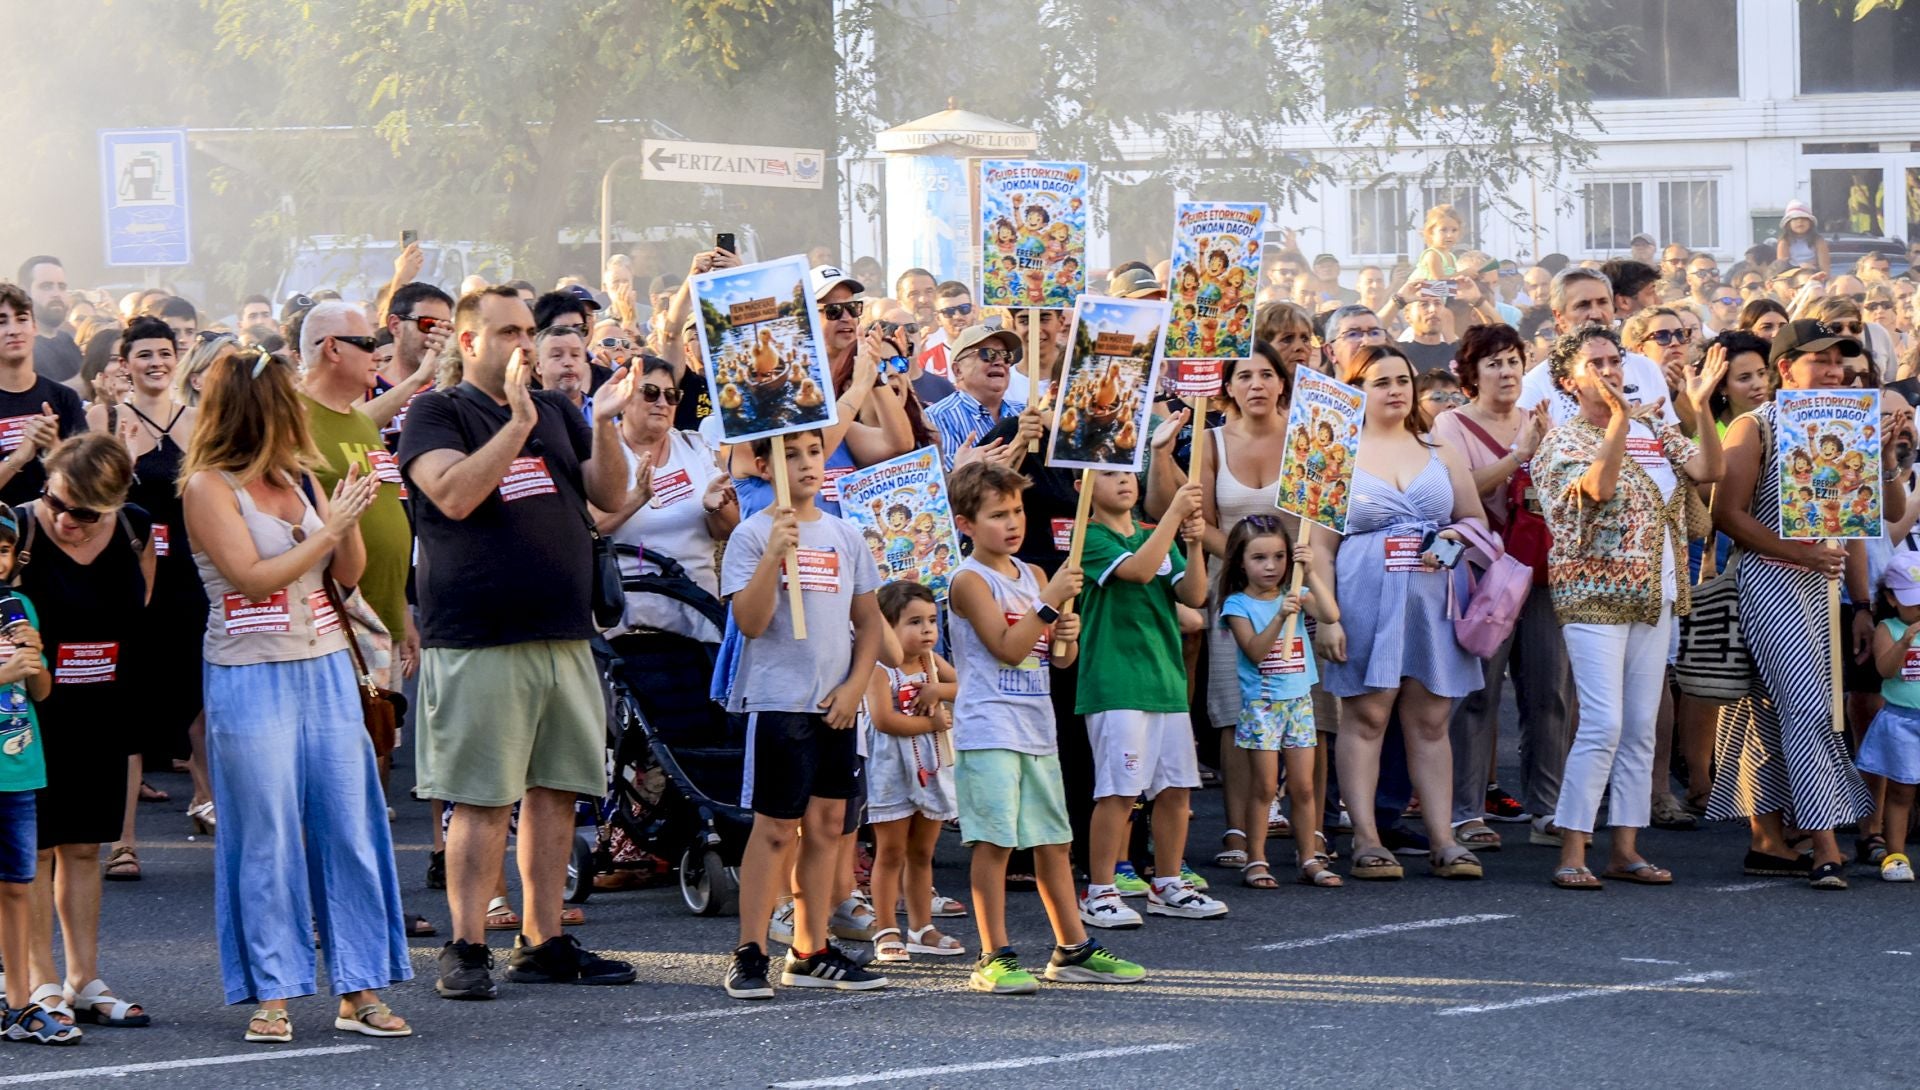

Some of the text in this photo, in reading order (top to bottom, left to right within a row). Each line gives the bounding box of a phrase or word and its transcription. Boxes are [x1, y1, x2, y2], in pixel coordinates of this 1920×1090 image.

[677, 153, 792, 176] ERTZAINTA
[995, 168, 1078, 183] GURE ETORKIZUNA
[1000, 180, 1074, 195] JOKOAN DAGO!
[1187, 209, 1257, 226] GURE ETORKIZUNA
[1190, 222, 1254, 238] JOKOAN DAGO!
[1305, 391, 1333, 407] JOKOAN
[1791, 397, 1870, 412] GURE ETORKIZUNA
[1795, 409, 1867, 422] JOKOAN DAGO!
[850, 474, 874, 494] GURE
[874, 461, 931, 484] ETORKIZUNA
[858, 481, 895, 503] JOKOAN
[897, 472, 928, 487] DAGO!
[1815, 488, 1839, 500] EZ!!!
[231, 605, 284, 617] BORROKAN
[63, 658, 112, 666] BORROKAN
[998, 669, 1022, 692] FEEL
